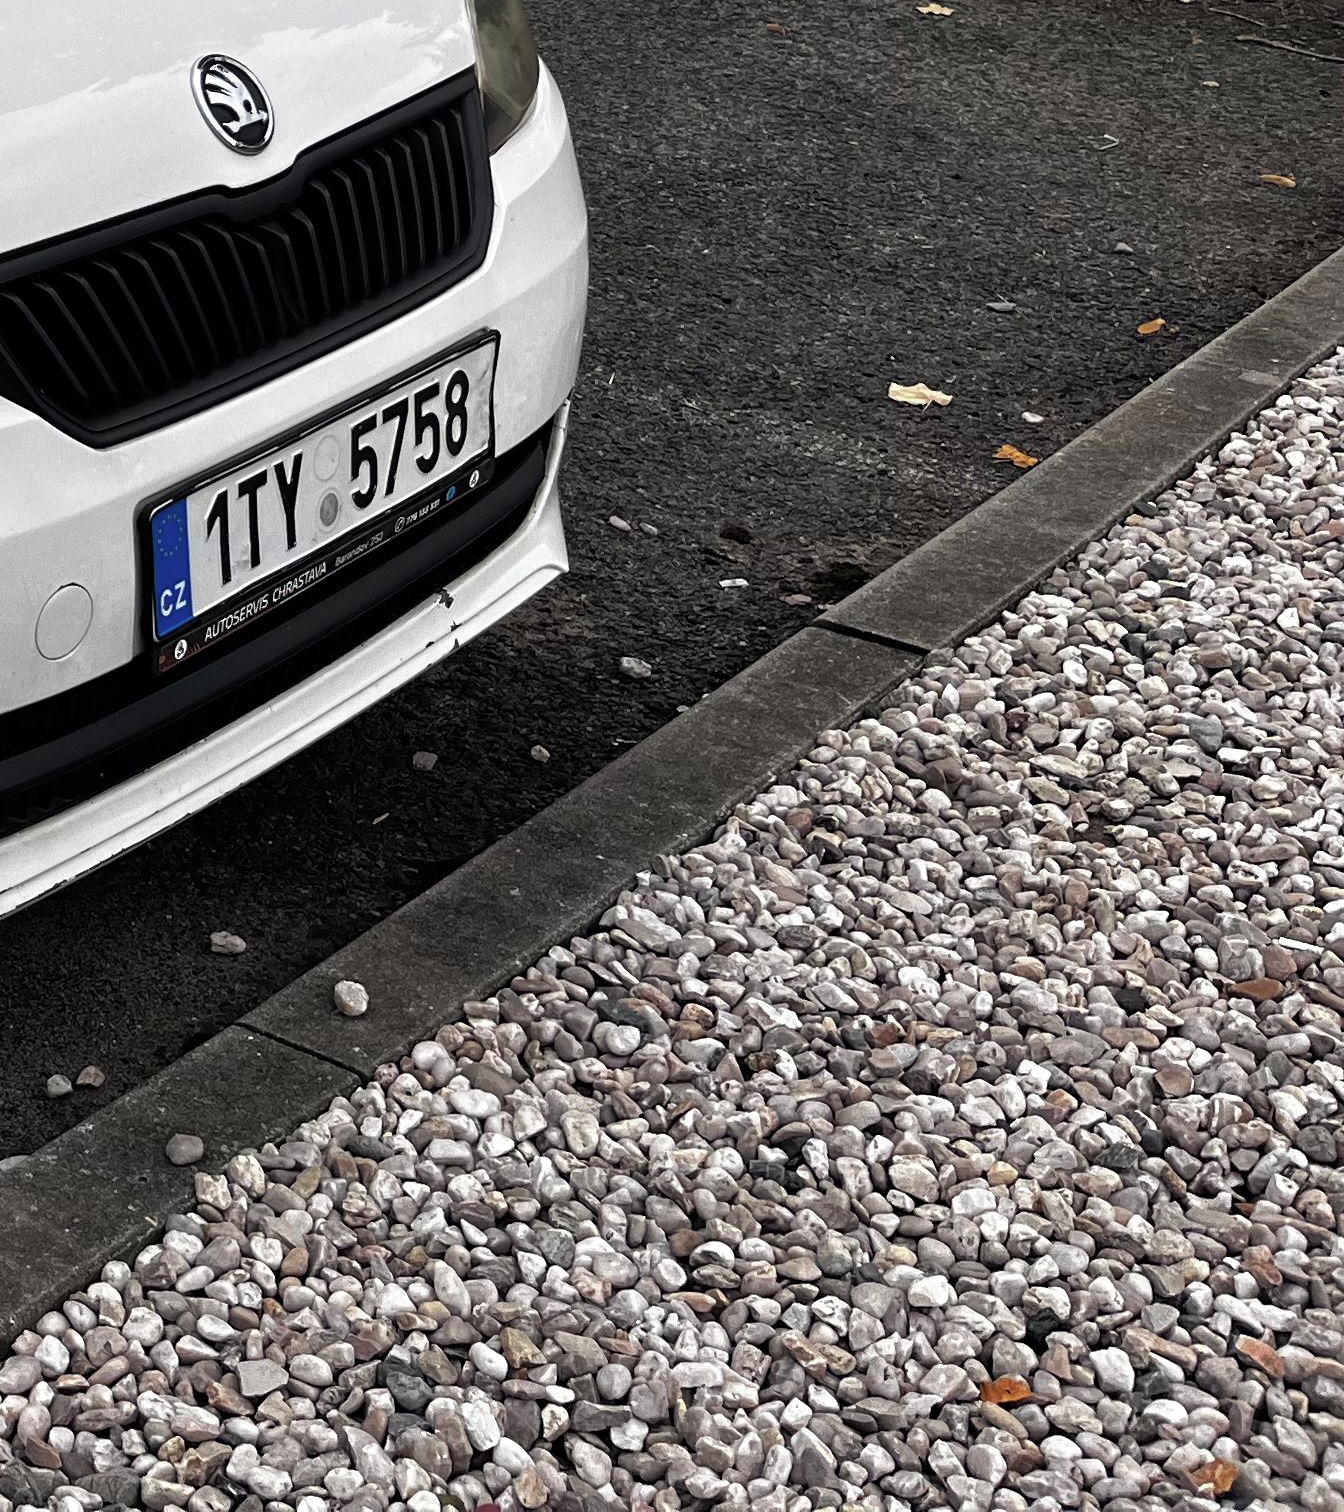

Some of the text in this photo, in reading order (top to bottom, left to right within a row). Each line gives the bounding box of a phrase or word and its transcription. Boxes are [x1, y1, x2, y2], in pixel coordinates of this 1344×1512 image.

[205, 369, 470, 586] 1TY 5758
[160, 579, 187, 617] CZ
[204, 593, 269, 642] AUTOSERVIS
[272, 561, 327, 603] CHRASTAVA
